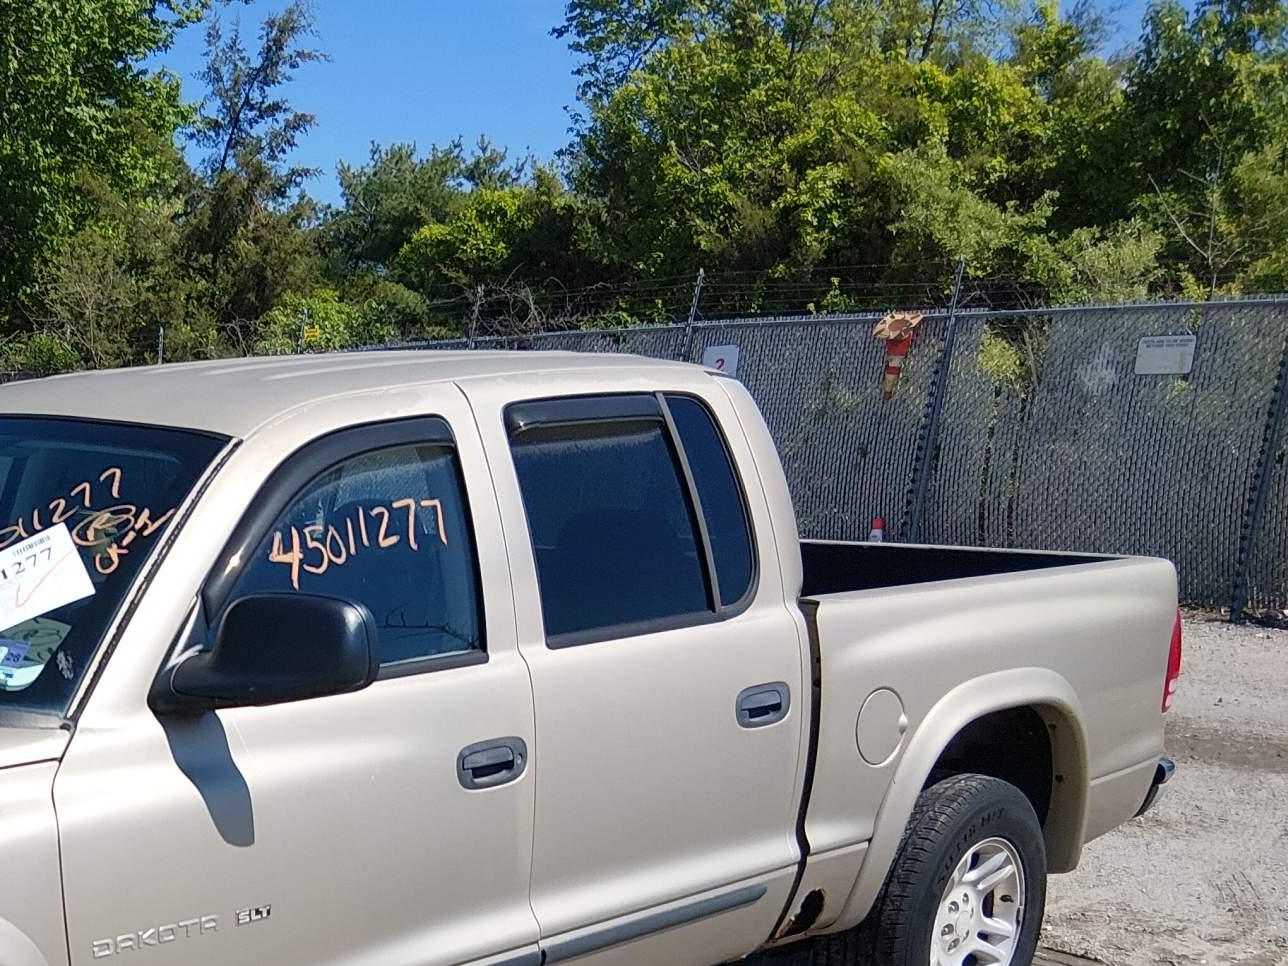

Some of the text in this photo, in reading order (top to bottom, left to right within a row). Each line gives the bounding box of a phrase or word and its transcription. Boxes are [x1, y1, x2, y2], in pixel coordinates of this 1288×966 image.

[268, 497, 448, 591] 45011277
[92, 904, 272, 960] DAKOTA SLT
